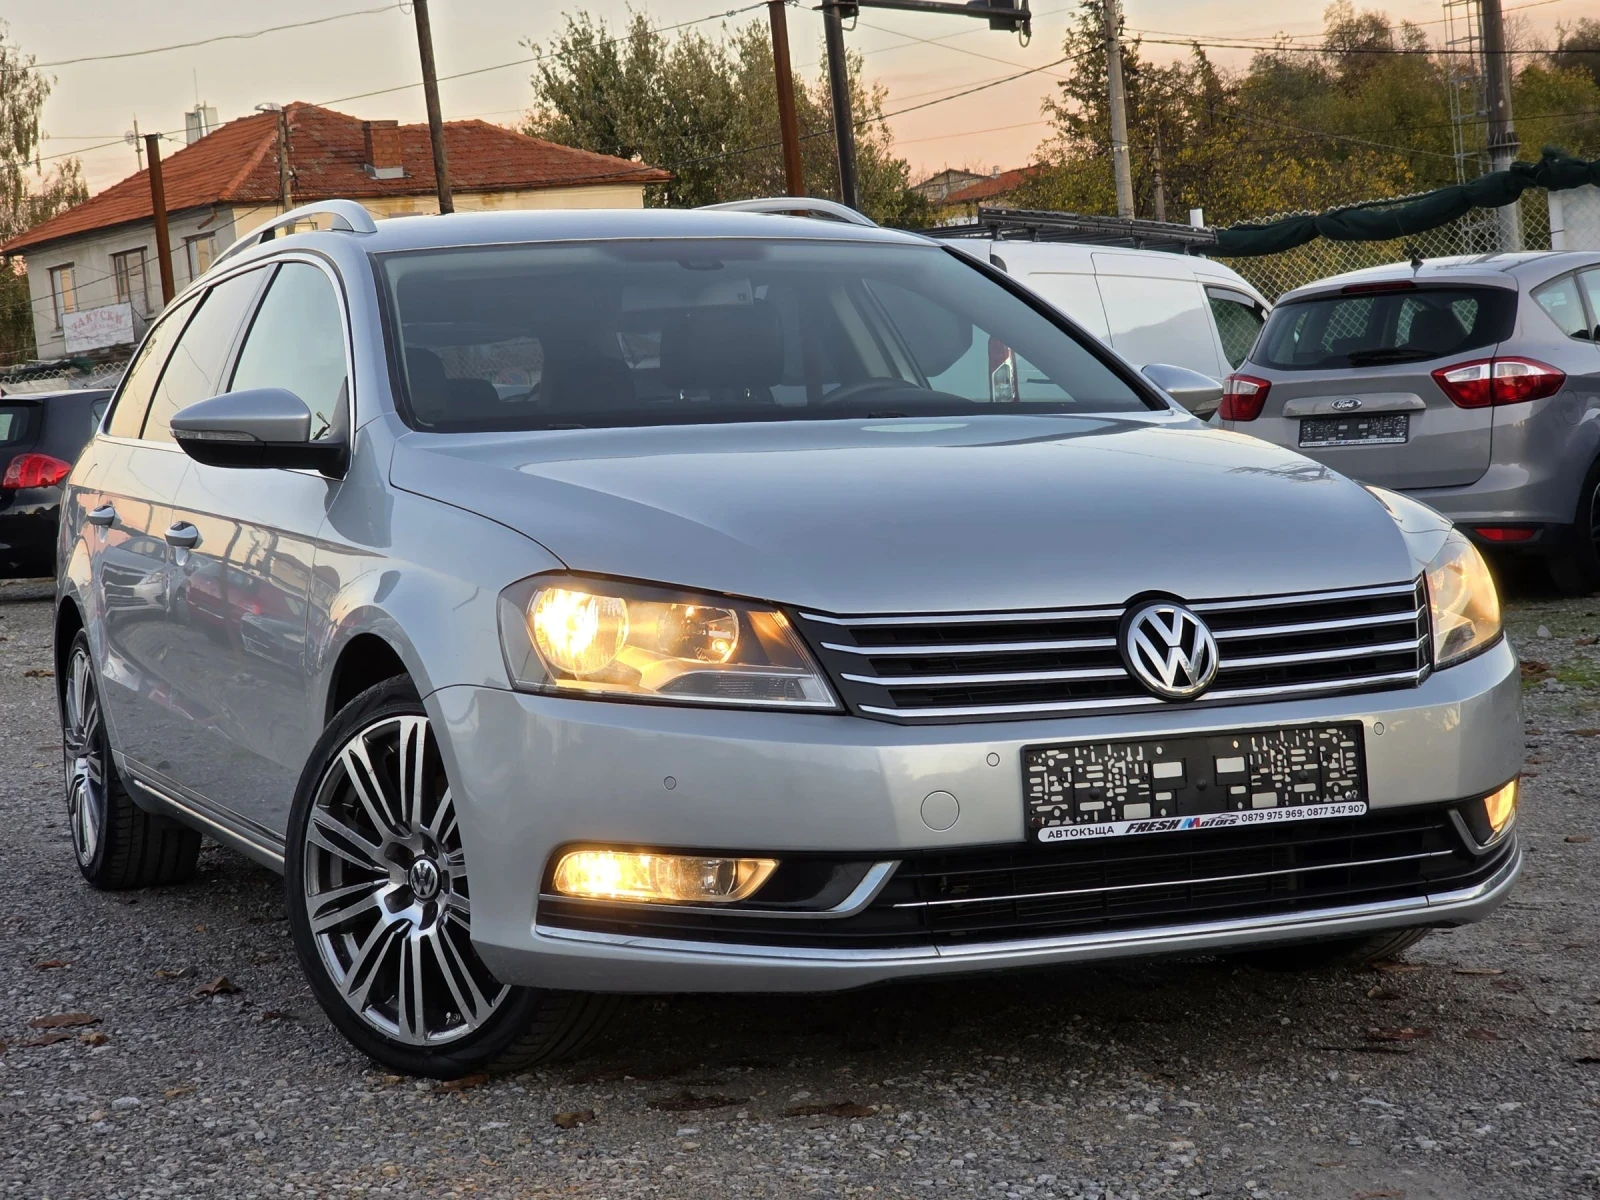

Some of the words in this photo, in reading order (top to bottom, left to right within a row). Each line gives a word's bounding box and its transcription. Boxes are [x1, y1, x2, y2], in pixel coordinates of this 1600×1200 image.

[1047, 825, 1114, 839] АВТОКЪЩА
[1125, 818, 1181, 834] FRESH
[1241, 813, 1265, 823] 0879
[1266, 811, 1283, 821] 975
[1285, 810, 1305, 820] 969;
[1306, 807, 1328, 817] 0877
[1330, 806, 1346, 815] 347
[1347, 804, 1365, 813] 907
